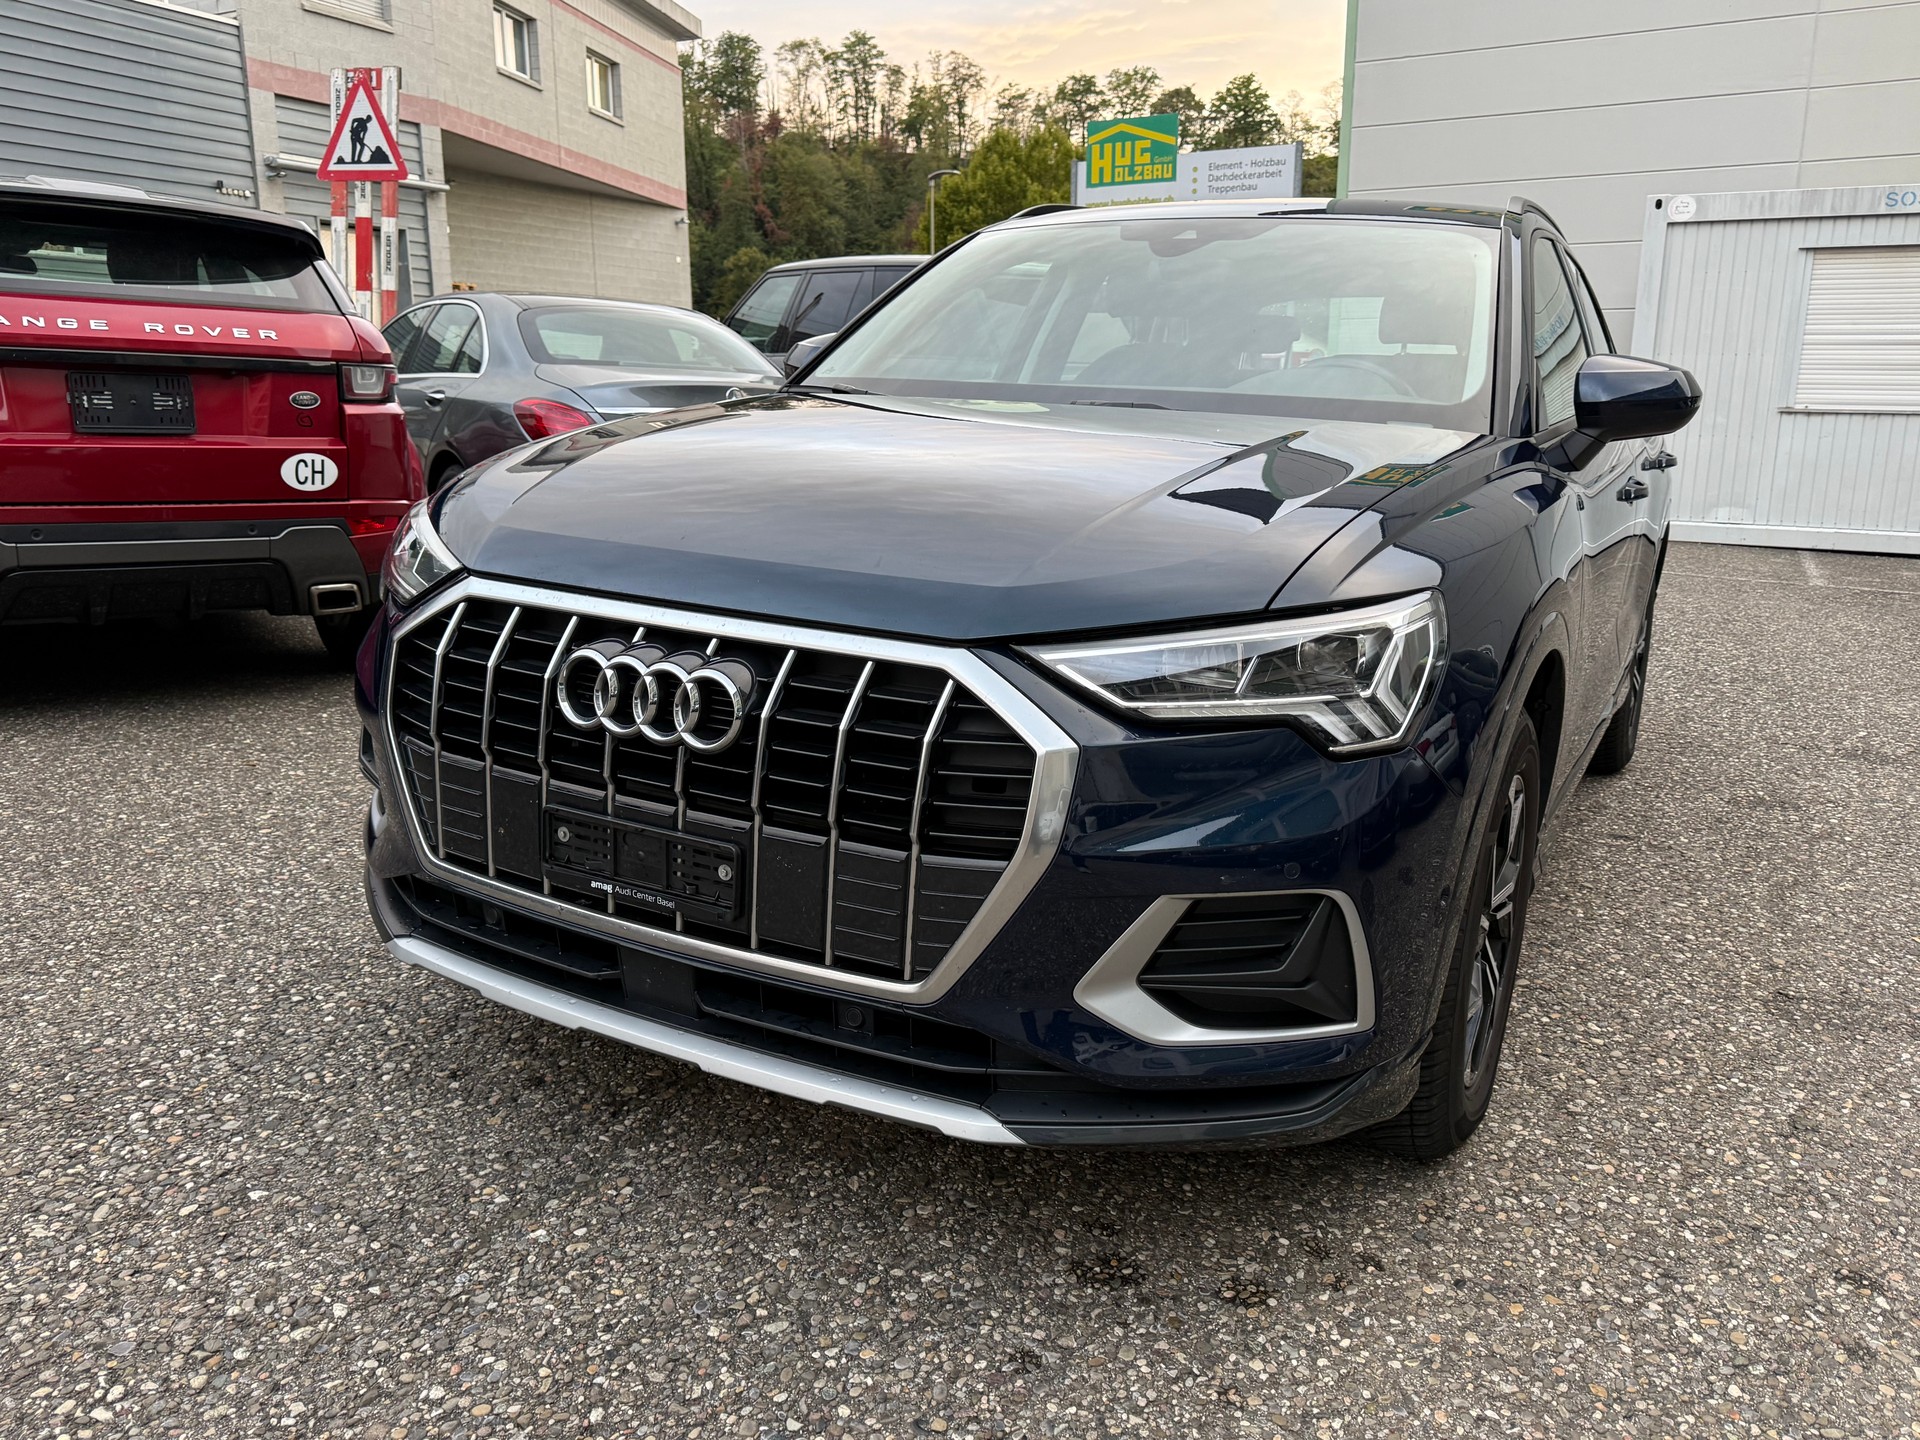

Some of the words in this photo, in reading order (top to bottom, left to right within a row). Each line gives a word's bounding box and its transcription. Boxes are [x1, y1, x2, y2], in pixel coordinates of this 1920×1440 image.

[1091, 140, 1151, 184] HUG
[1208, 161, 1243, 172] Element
[1250, 158, 1286, 168] Holzbau
[1207, 169, 1282, 182] Dachdeckerarbeit
[1207, 183, 1258, 194] Treppenbau
[1885, 191, 1920, 207] SO
[143, 322, 279, 340] ROVER
[295, 459, 325, 485] CH
[590, 881, 613, 893] amag
[614, 886, 632, 896] Audi
[632, 890, 656, 902] Center
[656, 897, 675, 909] Basel
